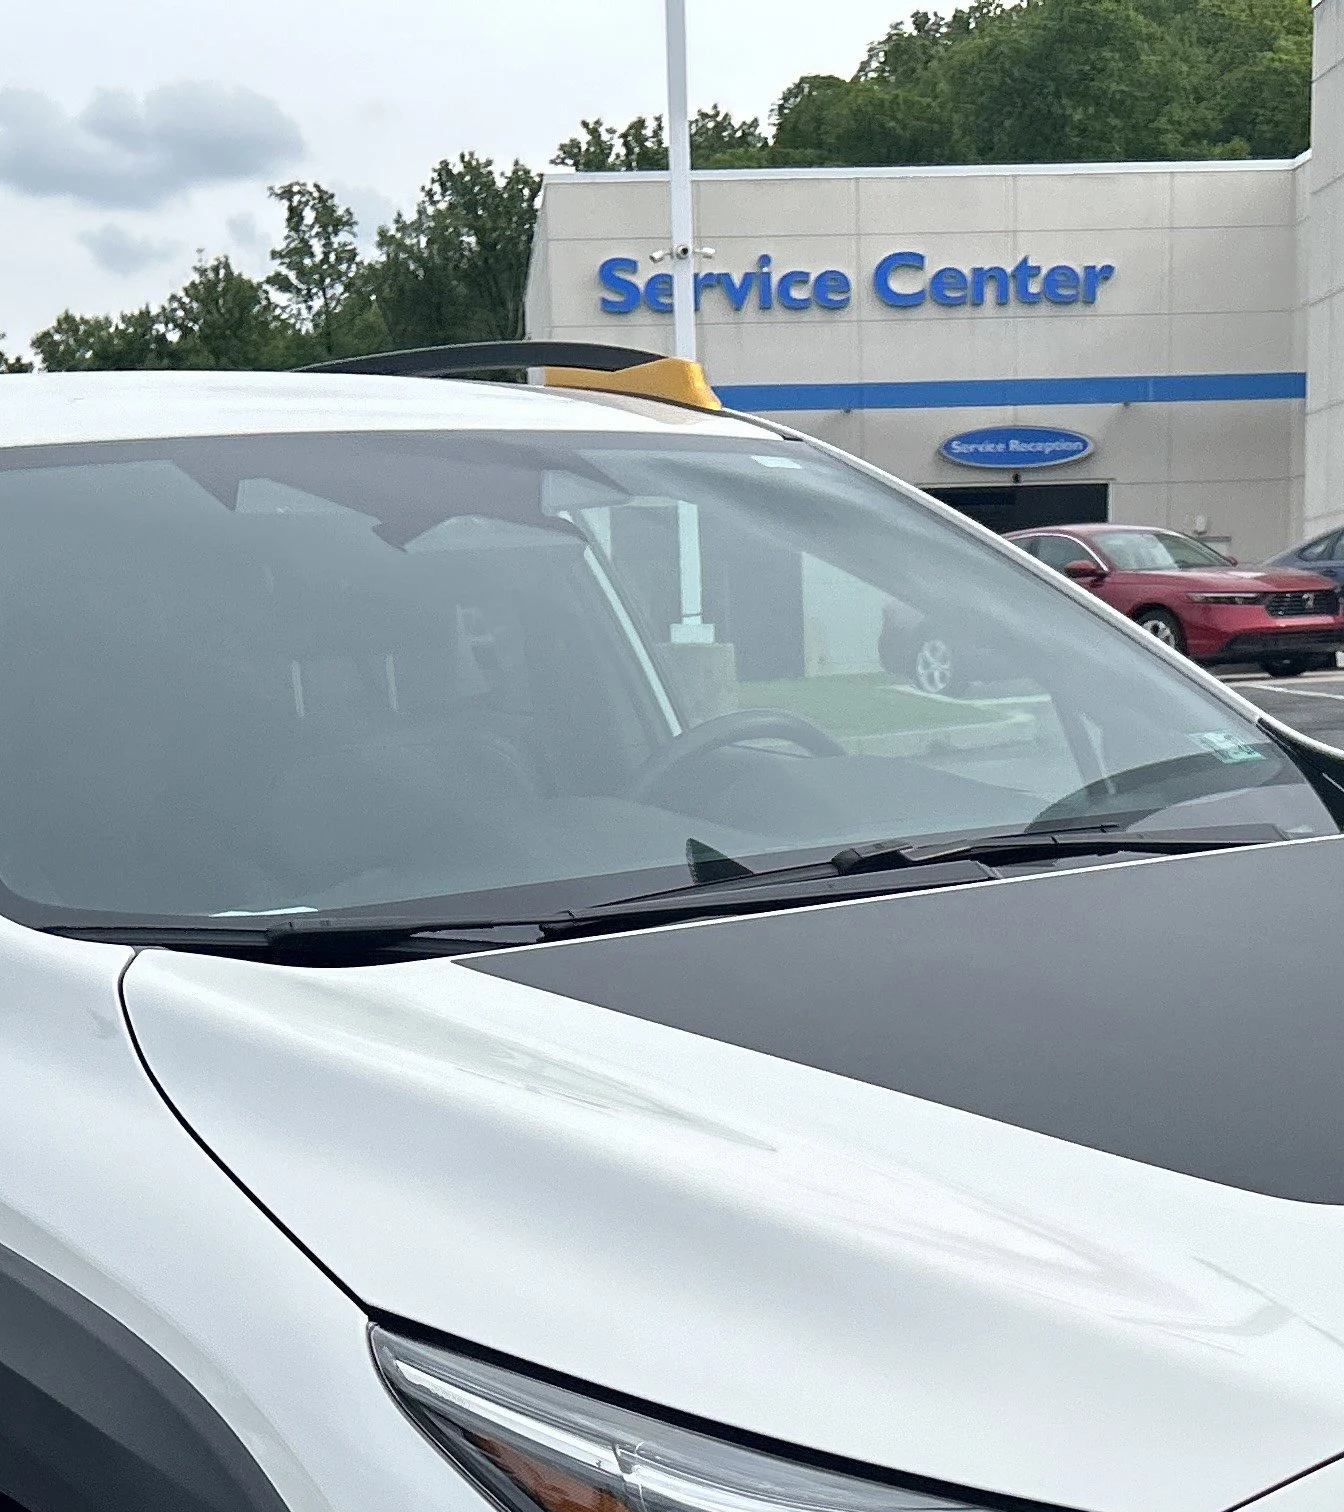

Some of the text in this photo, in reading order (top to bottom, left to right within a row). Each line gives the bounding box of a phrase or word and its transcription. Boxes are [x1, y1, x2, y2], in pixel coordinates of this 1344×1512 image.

[598, 251, 1116, 314] Service Center
[951, 440, 1006, 453] Service
